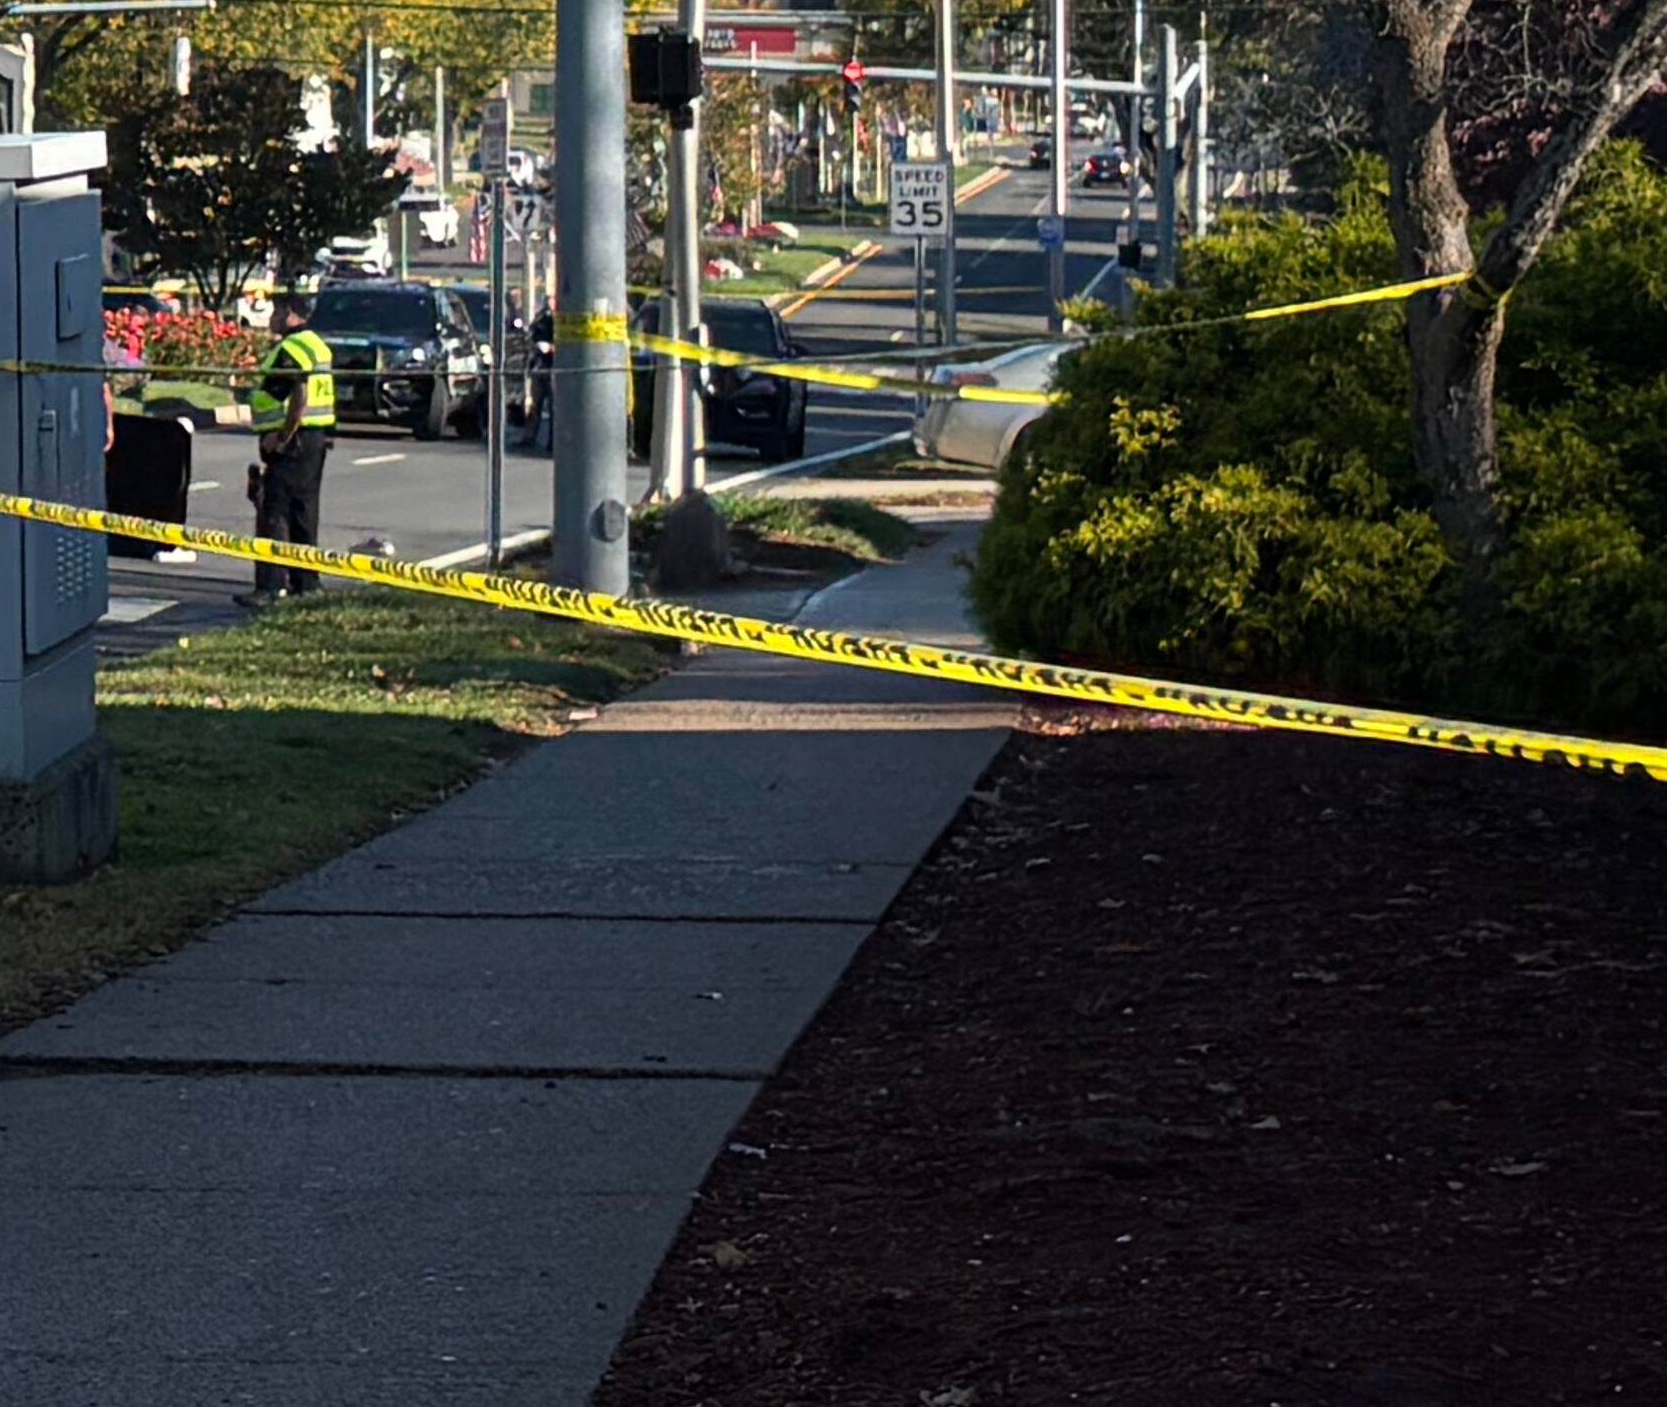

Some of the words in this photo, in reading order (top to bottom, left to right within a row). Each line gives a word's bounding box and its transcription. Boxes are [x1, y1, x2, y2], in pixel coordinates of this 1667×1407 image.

[894, 169, 944, 184] SPEED
[899, 185, 937, 197] LIMIT
[896, 200, 943, 227] 35
